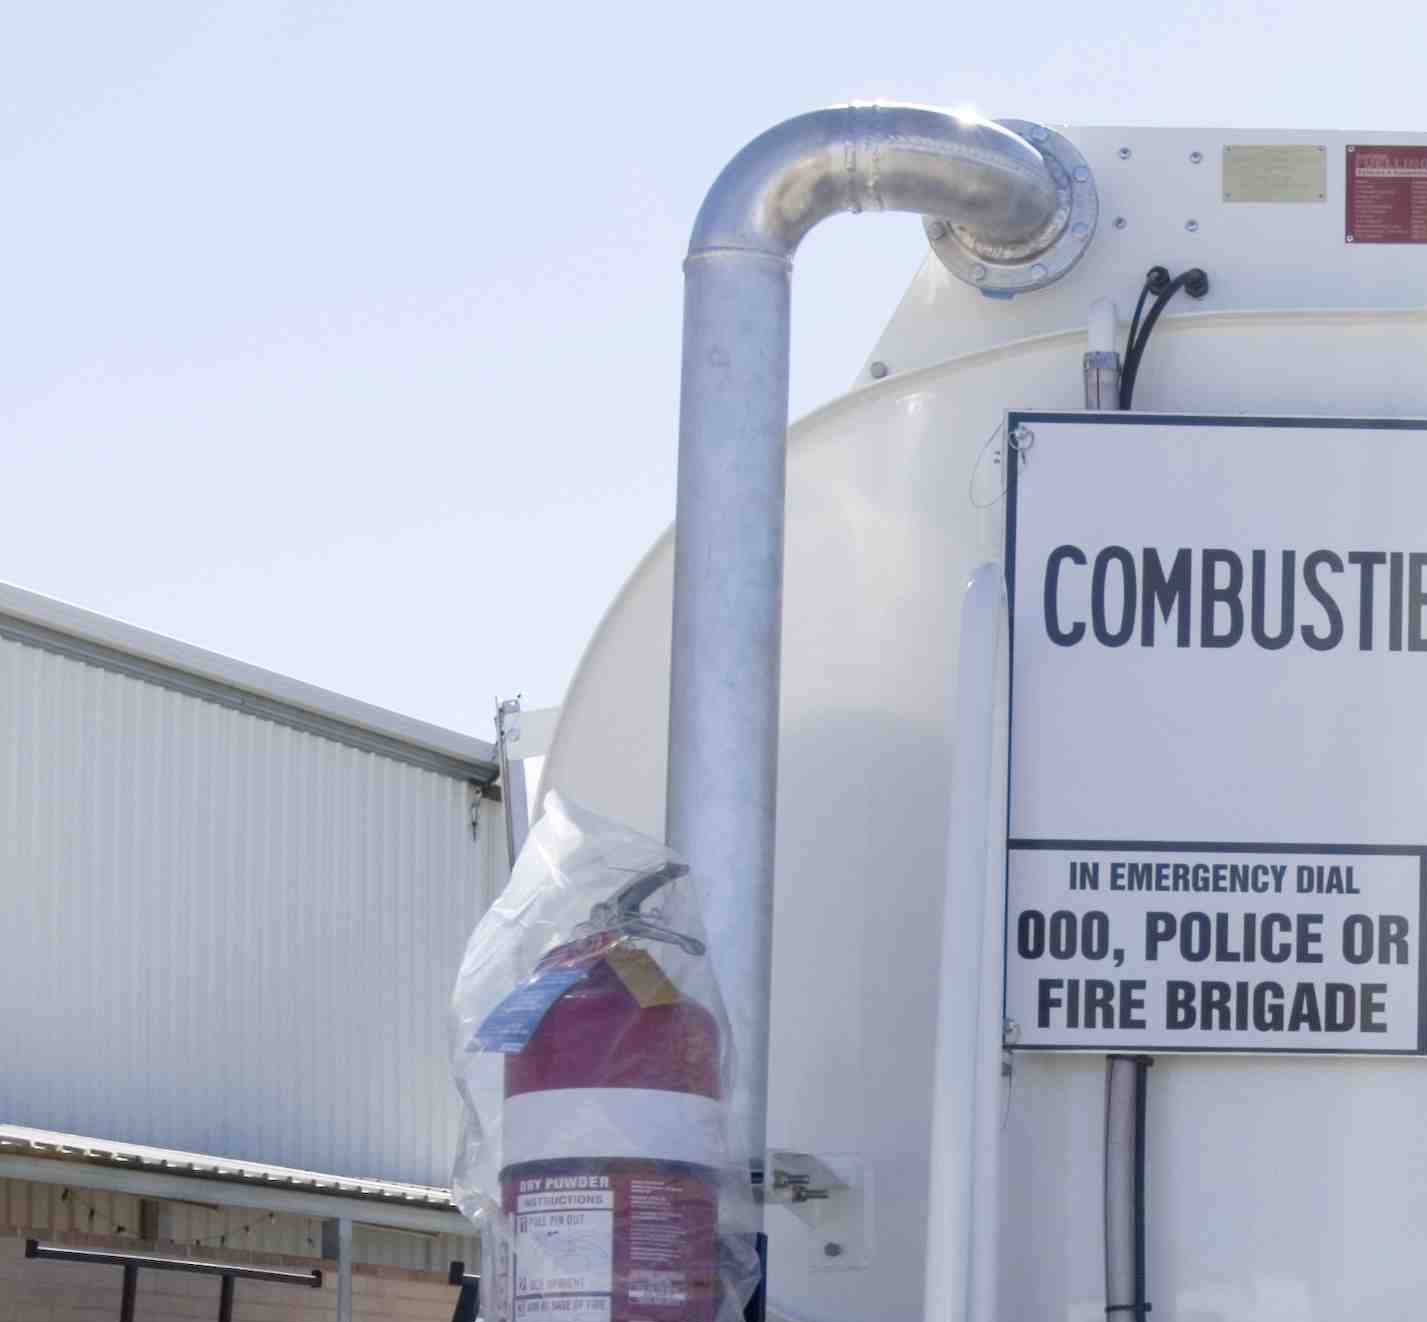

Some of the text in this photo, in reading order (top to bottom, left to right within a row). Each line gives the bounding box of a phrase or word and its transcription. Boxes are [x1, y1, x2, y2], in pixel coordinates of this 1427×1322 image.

[1068, 861, 1361, 895] IN EMERGENCY DIAL
[1016, 909, 1409, 968] 000, POLICE OR
[1036, 978, 1388, 1033] FIRE BRIGADE
[520, 1175, 609, 1193] DRY POWDER
